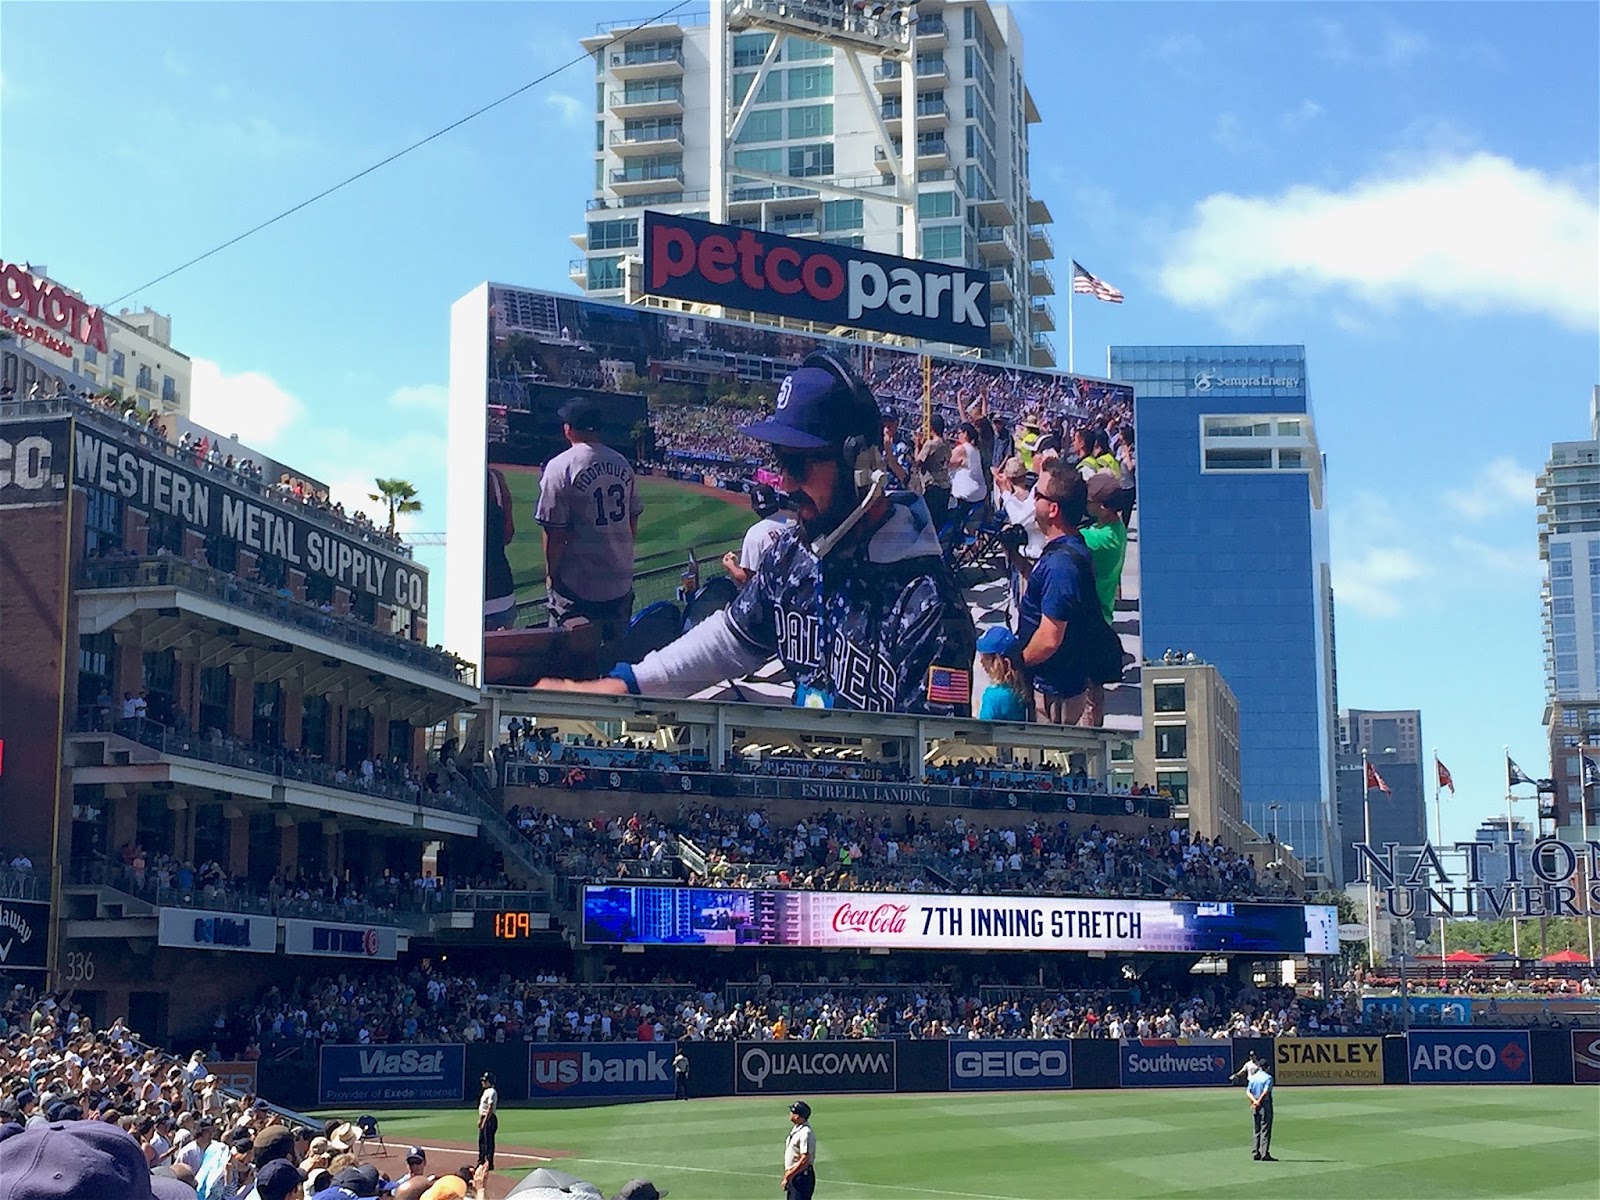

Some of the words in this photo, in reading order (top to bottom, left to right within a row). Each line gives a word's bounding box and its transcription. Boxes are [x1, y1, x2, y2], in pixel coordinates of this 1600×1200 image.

[0, 258, 108, 354] OYOTA
[1217, 376, 1259, 388] Sempra
[1261, 376, 1299, 388] Energy
[593, 484, 626, 526] 13
[75, 430, 210, 528] WESTERN
[222, 494, 301, 565] METAL
[307, 531, 388, 597] SUPPLY
[395, 568, 426, 613] CO.
[802, 783, 868, 799] ESTRELLA
[874, 787, 930, 802] LANDING
[1352, 839, 1600, 887] NATIO
[495, 912, 530, 938] 1:09
[921, 907, 963, 936] 7TH
[971, 908, 1043, 937] INNING
[1051, 910, 1142, 939] STRETCH
[66, 951, 95, 981] 336
[359, 1050, 444, 1074] ViaSat
[955, 1051, 1067, 1077] GEICO
[1128, 1053, 1214, 1073] Southwest
[1278, 1043, 1379, 1064] STANLEY
[1413, 1044, 1496, 1071] ARCO
[742, 1048, 888, 1088] QUALCOMM
[1279, 1070, 1331, 1079] PERFORMANCE
[1333, 1070, 1342, 1079] IN
[327, 1089, 368, 1099] Provider
[371, 1088, 382, 1098] of
[420, 1087, 457, 1097] Internet
